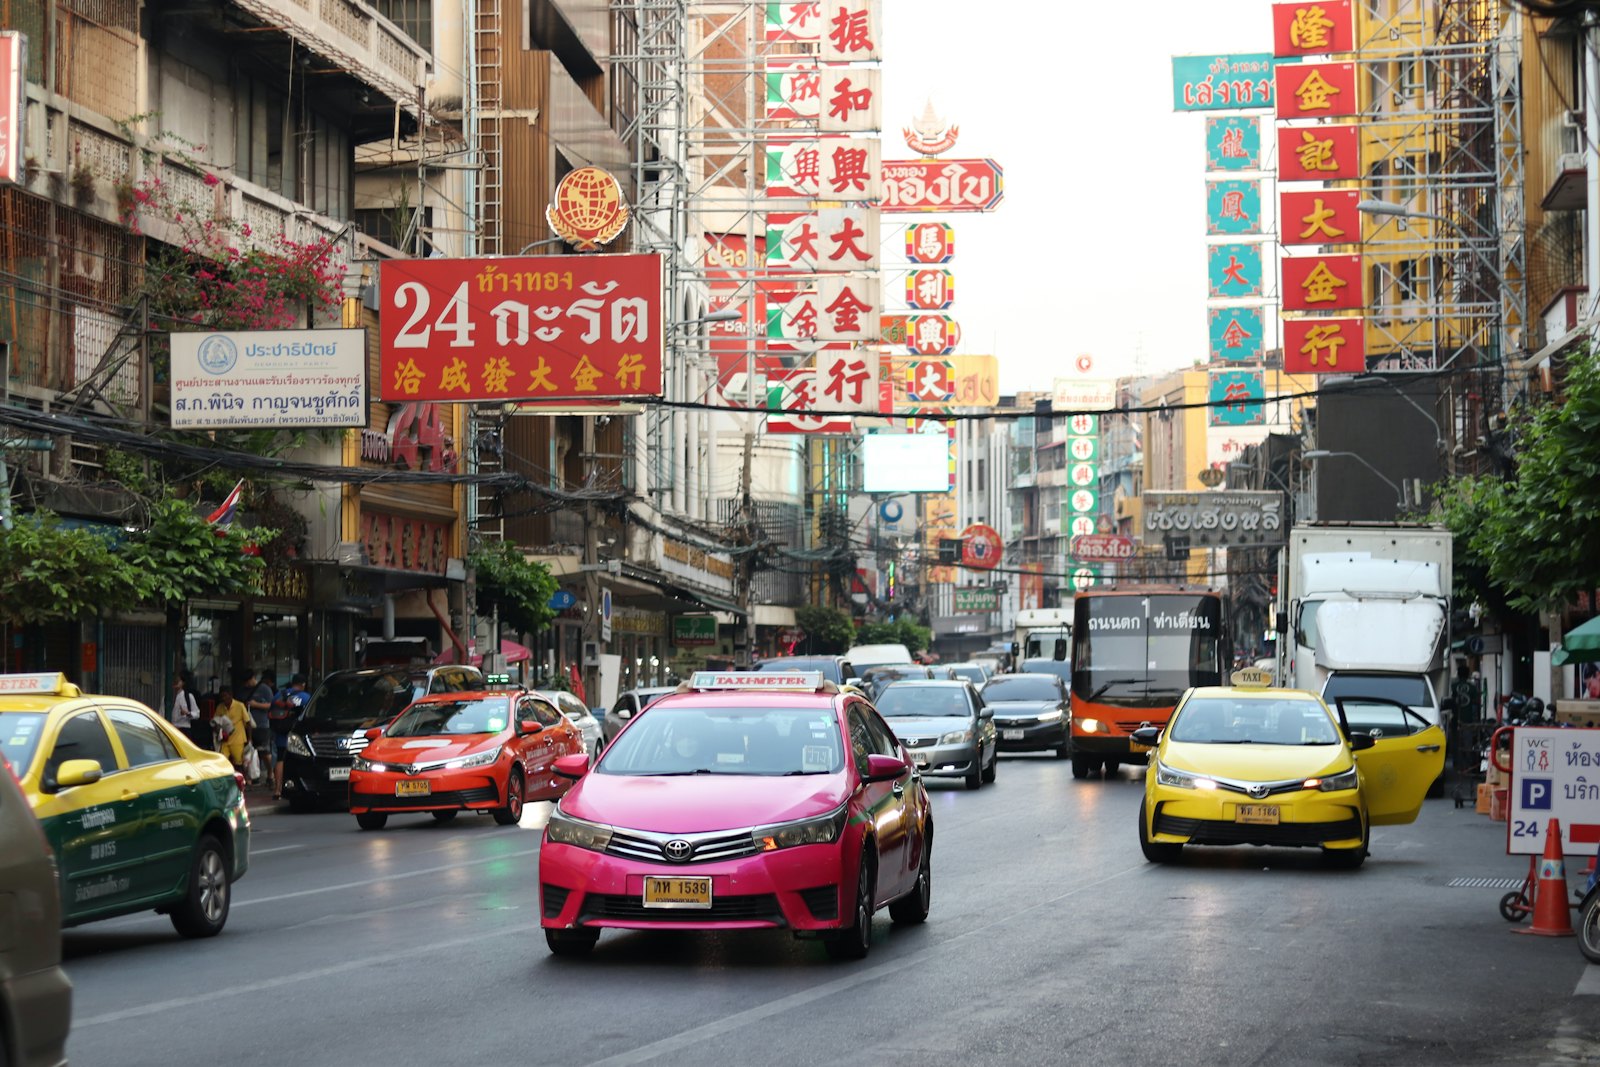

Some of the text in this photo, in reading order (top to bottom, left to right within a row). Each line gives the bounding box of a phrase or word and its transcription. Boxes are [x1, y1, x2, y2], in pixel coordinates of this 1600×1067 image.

[1184, 75, 1275, 105] เล่งหง
[1289, 5, 1347, 367] 隆金記大金行
[824, 6, 875, 405] 振和興大金行
[476, 264, 574, 293] ห้างทอง
[1217, 127, 1251, 414] 龍鳳大金行
[393, 279, 649, 349] 24 กะรัต
[245, 341, 338, 357] ประชาธิปัตย์
[176, 393, 244, 411] ส.ก.พินิจ
[1142, 598, 1151, 619] 1
[1088, 611, 1211, 630] ถนนตก ท่าเตียน
[1241, 672, 1262, 682] TAXI
[1527, 739, 1550, 749] WC
[1529, 783, 1546, 806] P
[1513, 820, 1539, 838] 24
[679, 881, 707, 894] 1539
